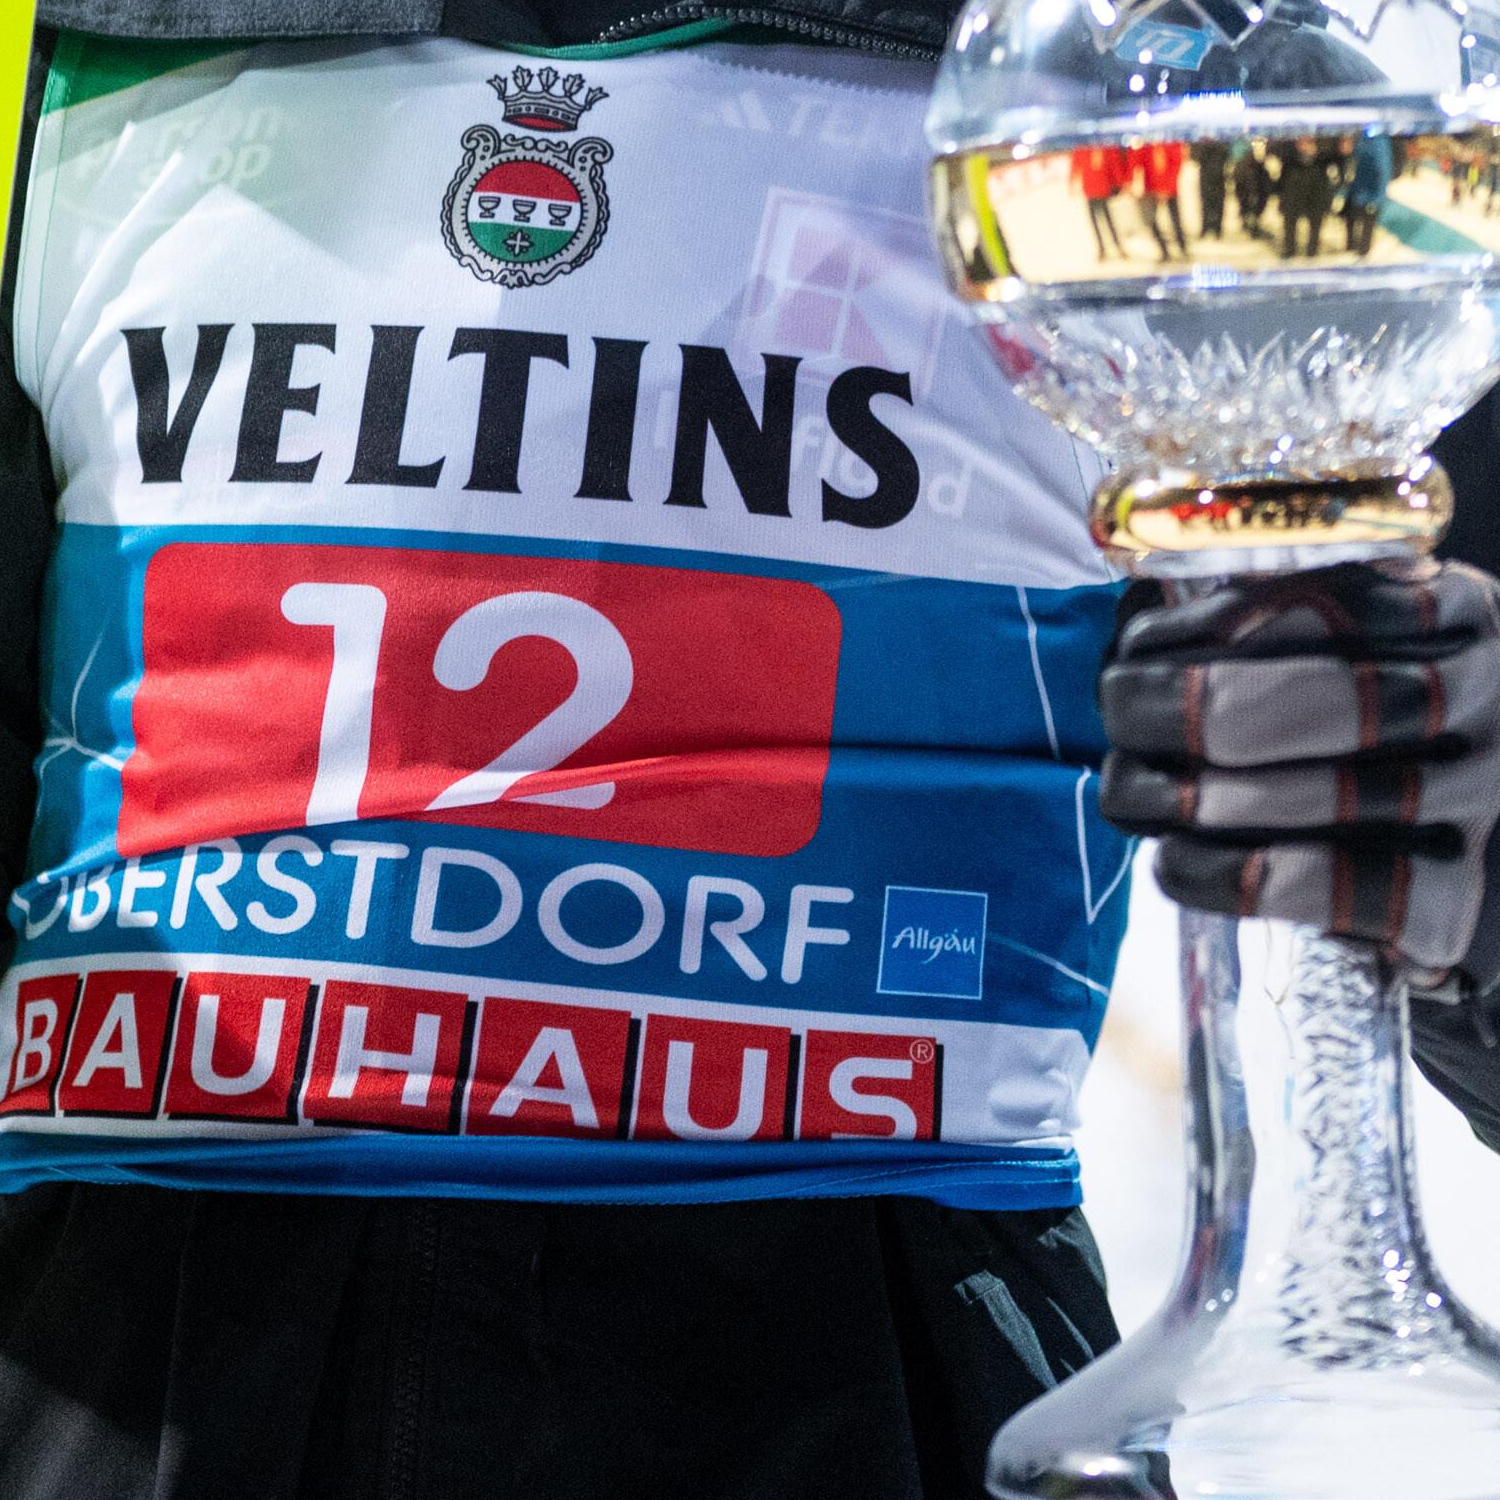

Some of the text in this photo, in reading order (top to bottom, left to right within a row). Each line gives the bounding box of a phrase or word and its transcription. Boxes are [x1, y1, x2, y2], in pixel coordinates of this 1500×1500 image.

[119, 323, 922, 530] VELTINS
[279, 581, 635, 828] 12
[891, 925, 976, 965] Allgäu
